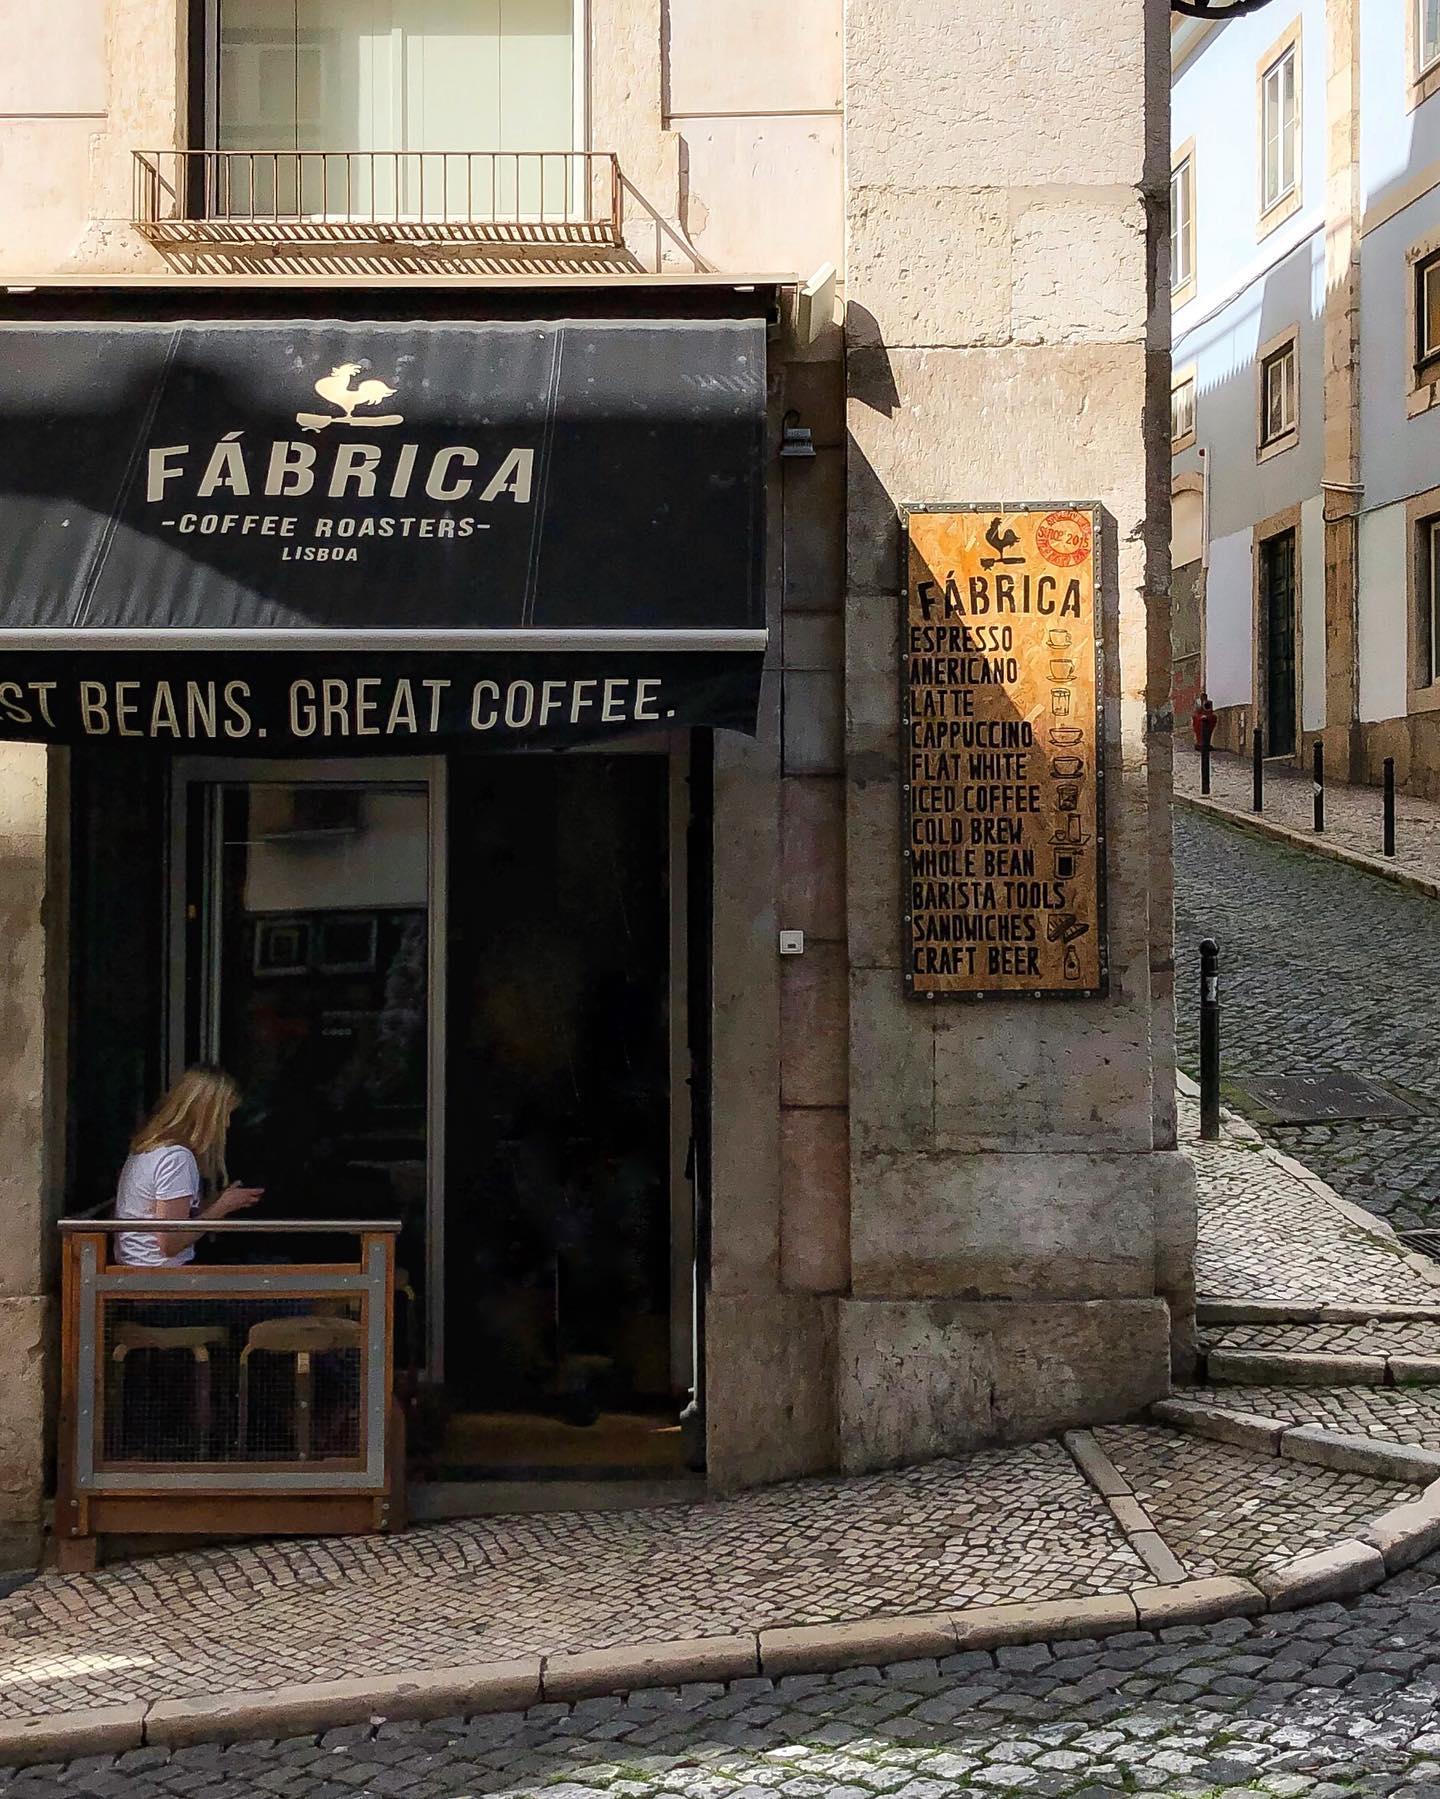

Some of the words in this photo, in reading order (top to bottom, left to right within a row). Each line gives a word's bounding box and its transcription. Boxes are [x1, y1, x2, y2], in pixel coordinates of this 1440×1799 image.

[147, 431, 535, 503] FÁBRICA
[281, 546, 359, 562] LISBOA
[1066, 533, 1089, 548] 2015
[916, 570, 1081, 621] FÁBRICA
[911, 625, 1013, 653] ESPRESSO
[911, 657, 1018, 685] AMERICANO
[0, 681, 57, 728] ST
[80, 679, 268, 738] BEANS.
[290, 678, 452, 737] GREAT
[471, 678, 676, 731] COFFEE.
[911, 689, 974, 717] LATTE
[911, 721, 1033, 749] CAPPUCCINO
[912, 753, 961, 780] FLAT
[969, 753, 1027, 780] WHITE
[912, 785, 956, 813] ICED
[963, 784, 1040, 813] COFFEE
[912, 818, 963, 845] COLD
[970, 817, 1023, 845] BREW
[912, 849, 976, 877] WHOLE
[984, 849, 1035, 877] BEAN
[913, 882, 997, 910] BARISTA
[1004, 882, 1065, 909] TOOLS
[913, 914, 1036, 942] SANDWICHES
[913, 947, 977, 975] CRAFT
[988, 947, 1041, 976] BEER
